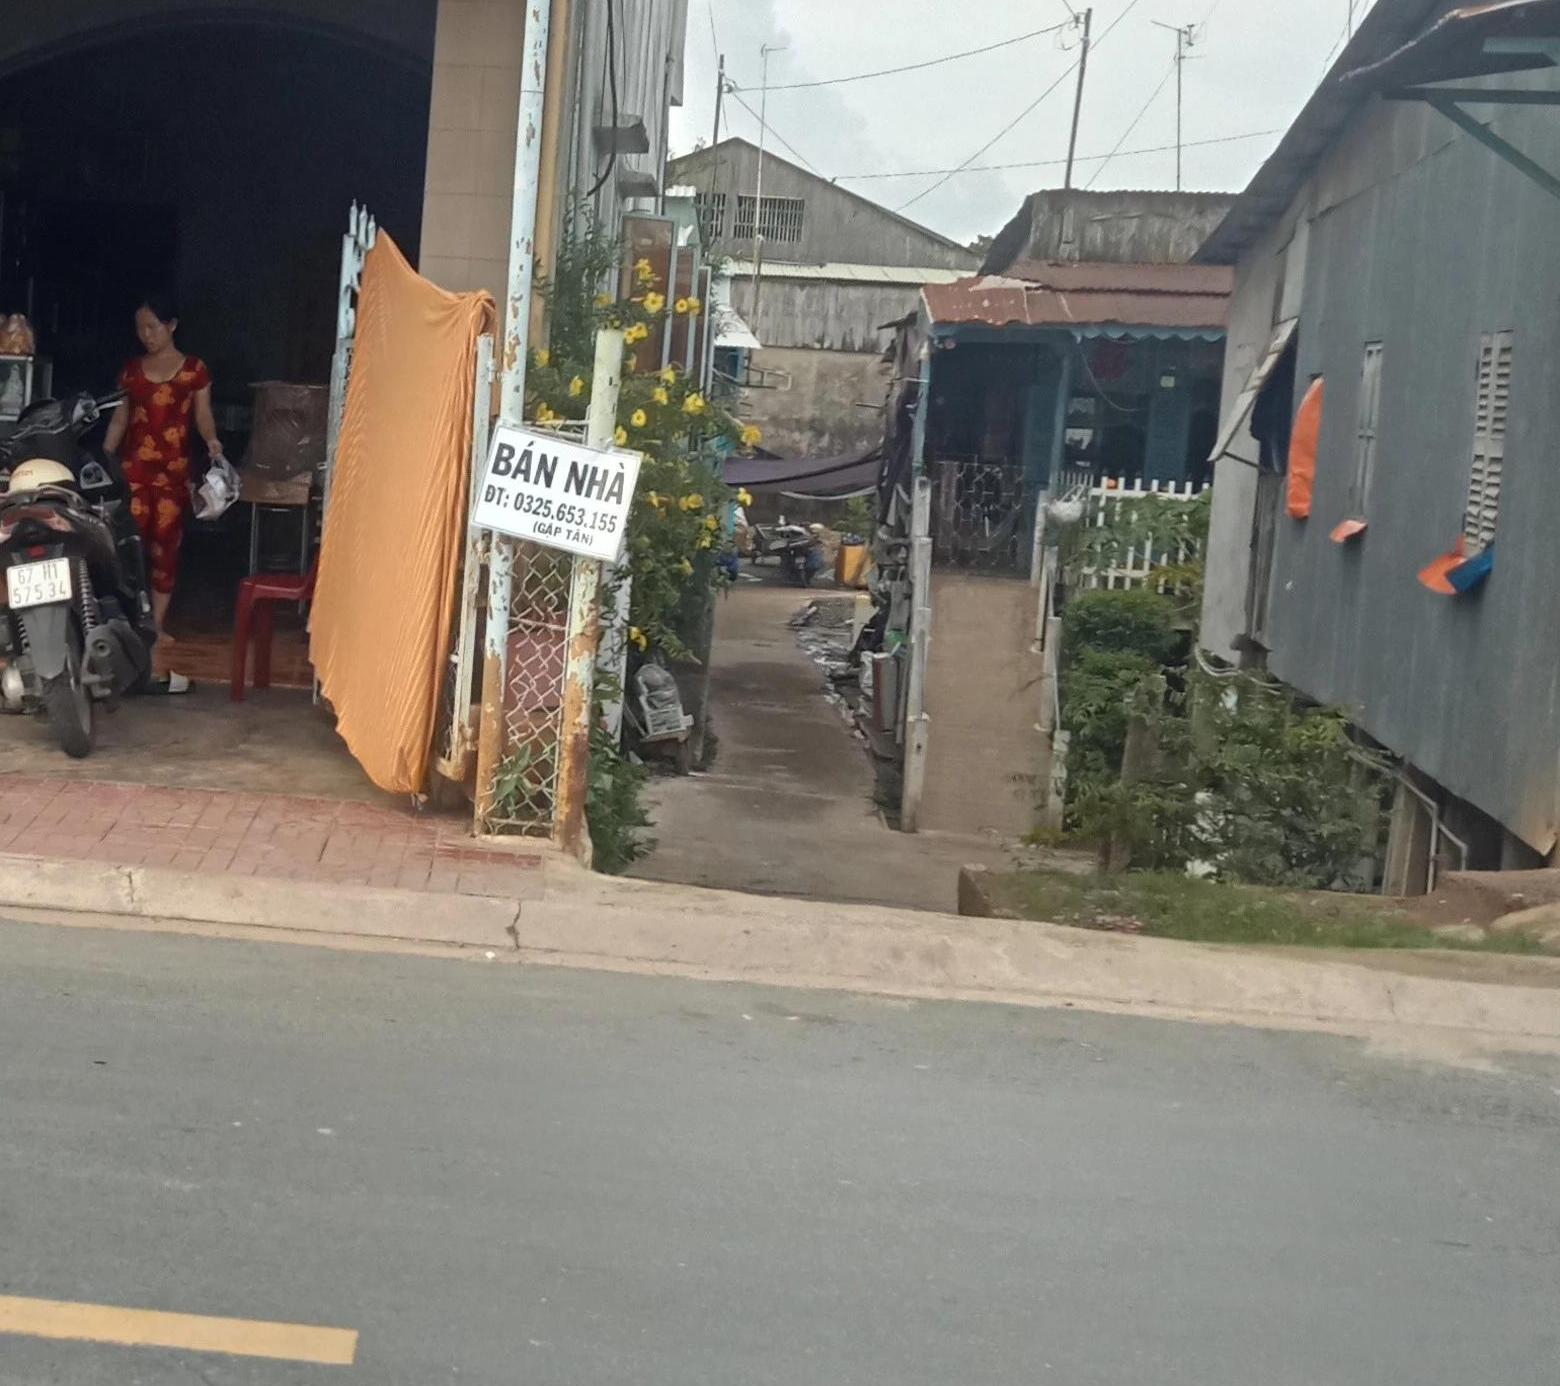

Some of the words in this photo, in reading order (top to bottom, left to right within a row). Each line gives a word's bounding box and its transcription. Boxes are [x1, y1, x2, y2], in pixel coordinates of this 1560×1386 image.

[491, 440, 559, 489] BÁN
[563, 461, 626, 505] NHÀ
[484, 484, 510, 509] ĐT:
[513, 492, 618, 534] 0325.653.155
[17, 568, 33, 585] 67
